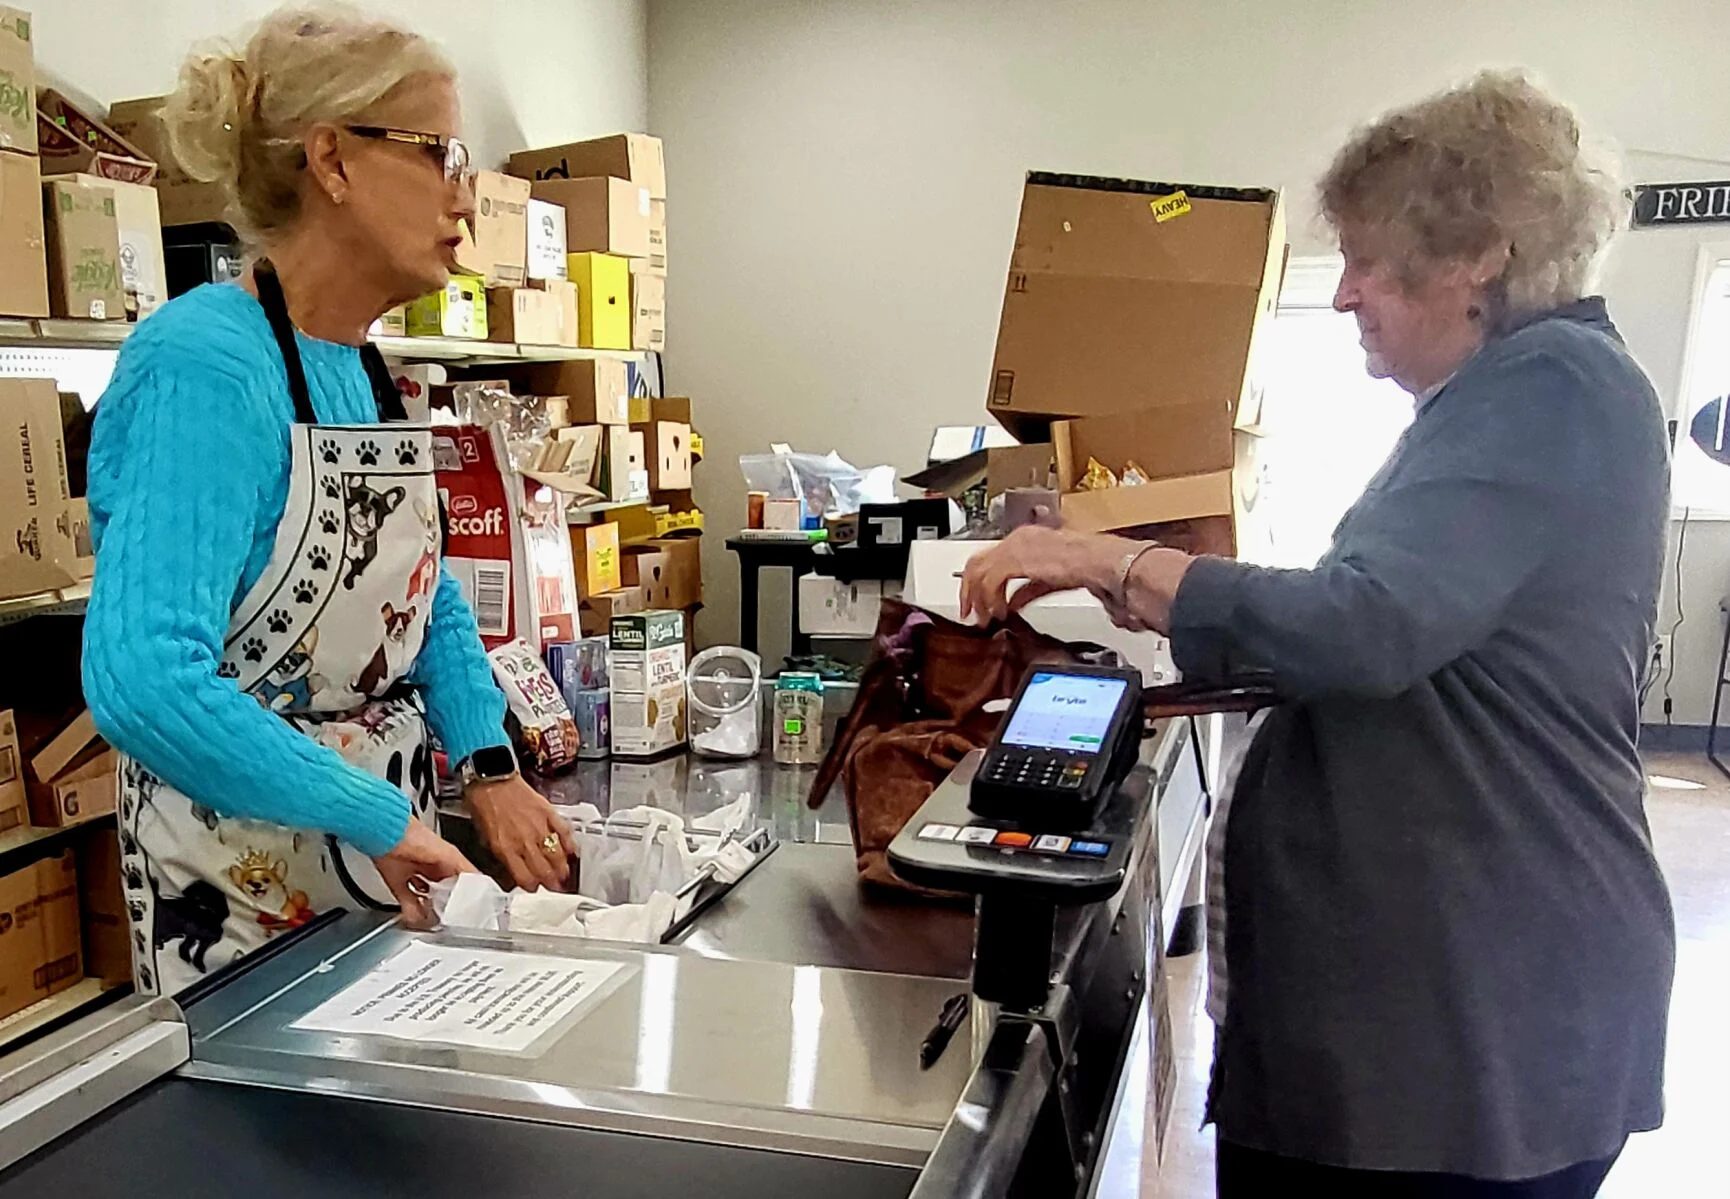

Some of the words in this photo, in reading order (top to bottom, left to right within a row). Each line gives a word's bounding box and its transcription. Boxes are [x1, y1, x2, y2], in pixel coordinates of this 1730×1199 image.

[1154, 195, 1188, 217] HEAVY
[463, 442, 474, 456] 2
[63, 790, 80, 817] G
